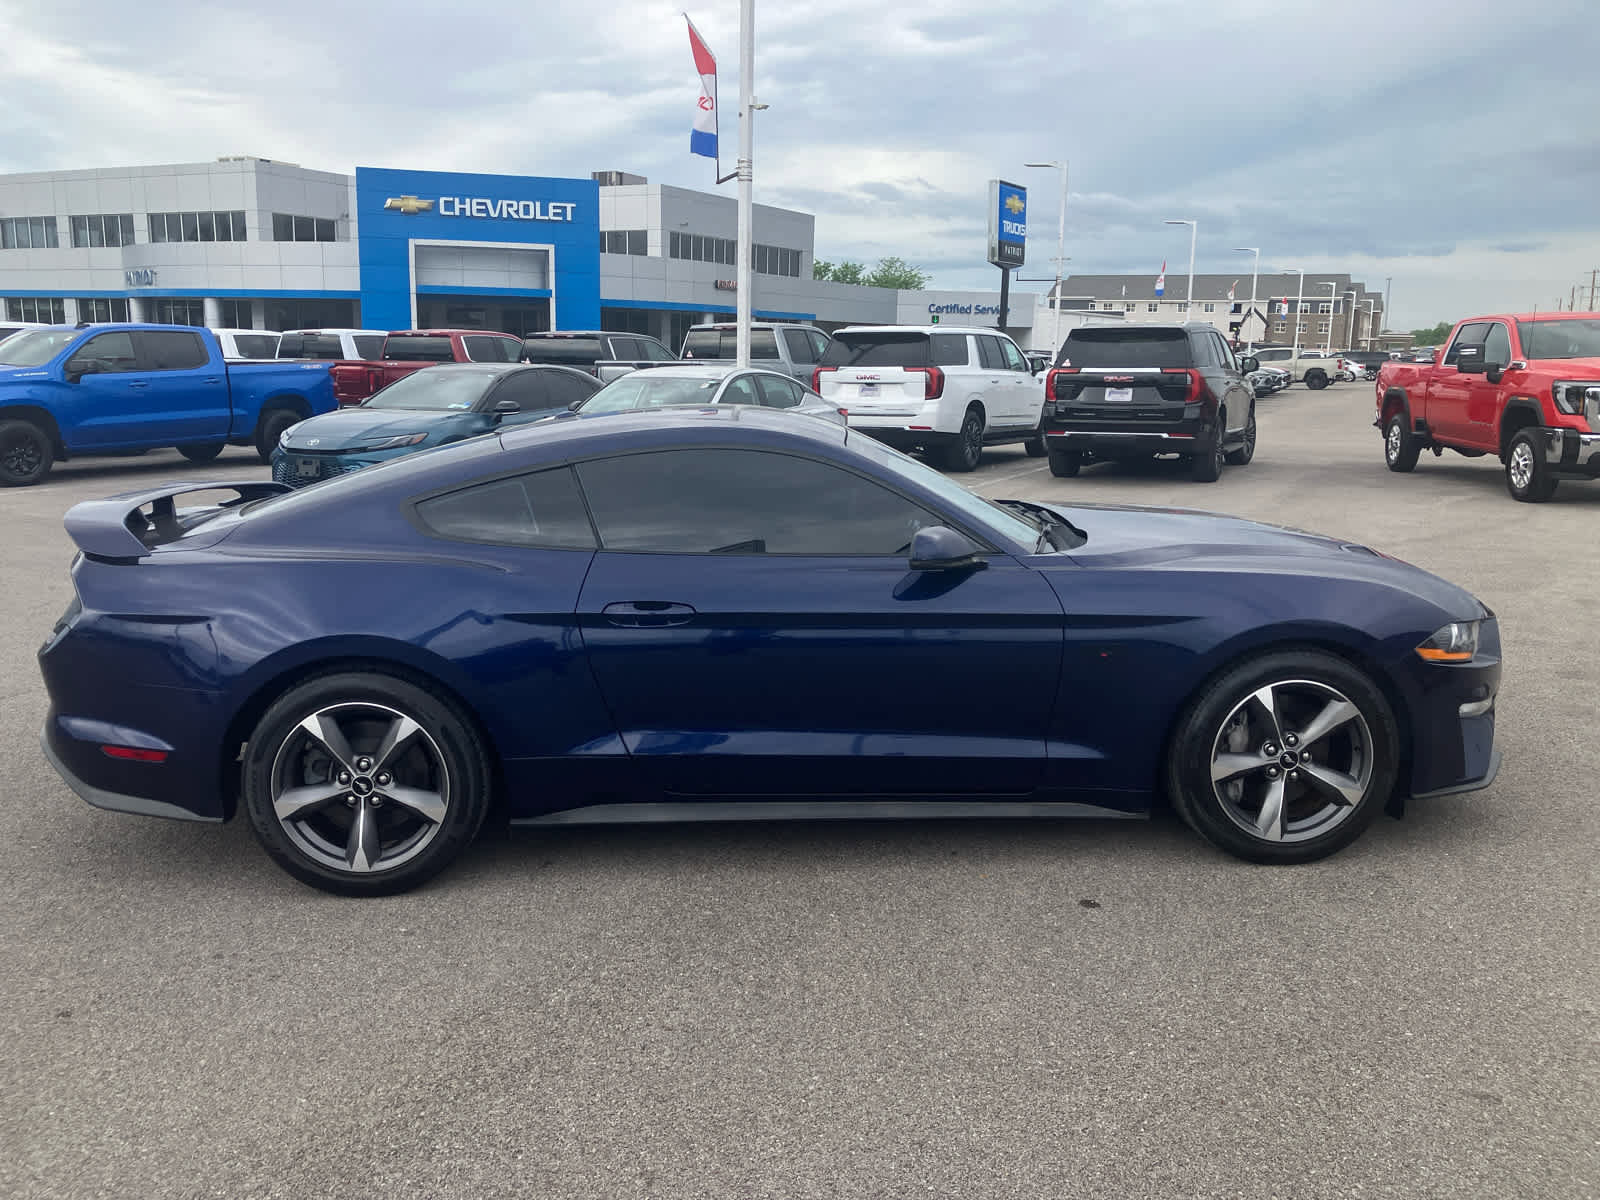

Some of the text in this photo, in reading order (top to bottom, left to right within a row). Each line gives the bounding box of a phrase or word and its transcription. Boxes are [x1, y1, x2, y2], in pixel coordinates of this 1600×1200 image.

[439, 196, 577, 221] CHEVROLET
[928, 303, 1010, 315] Certified Servi
